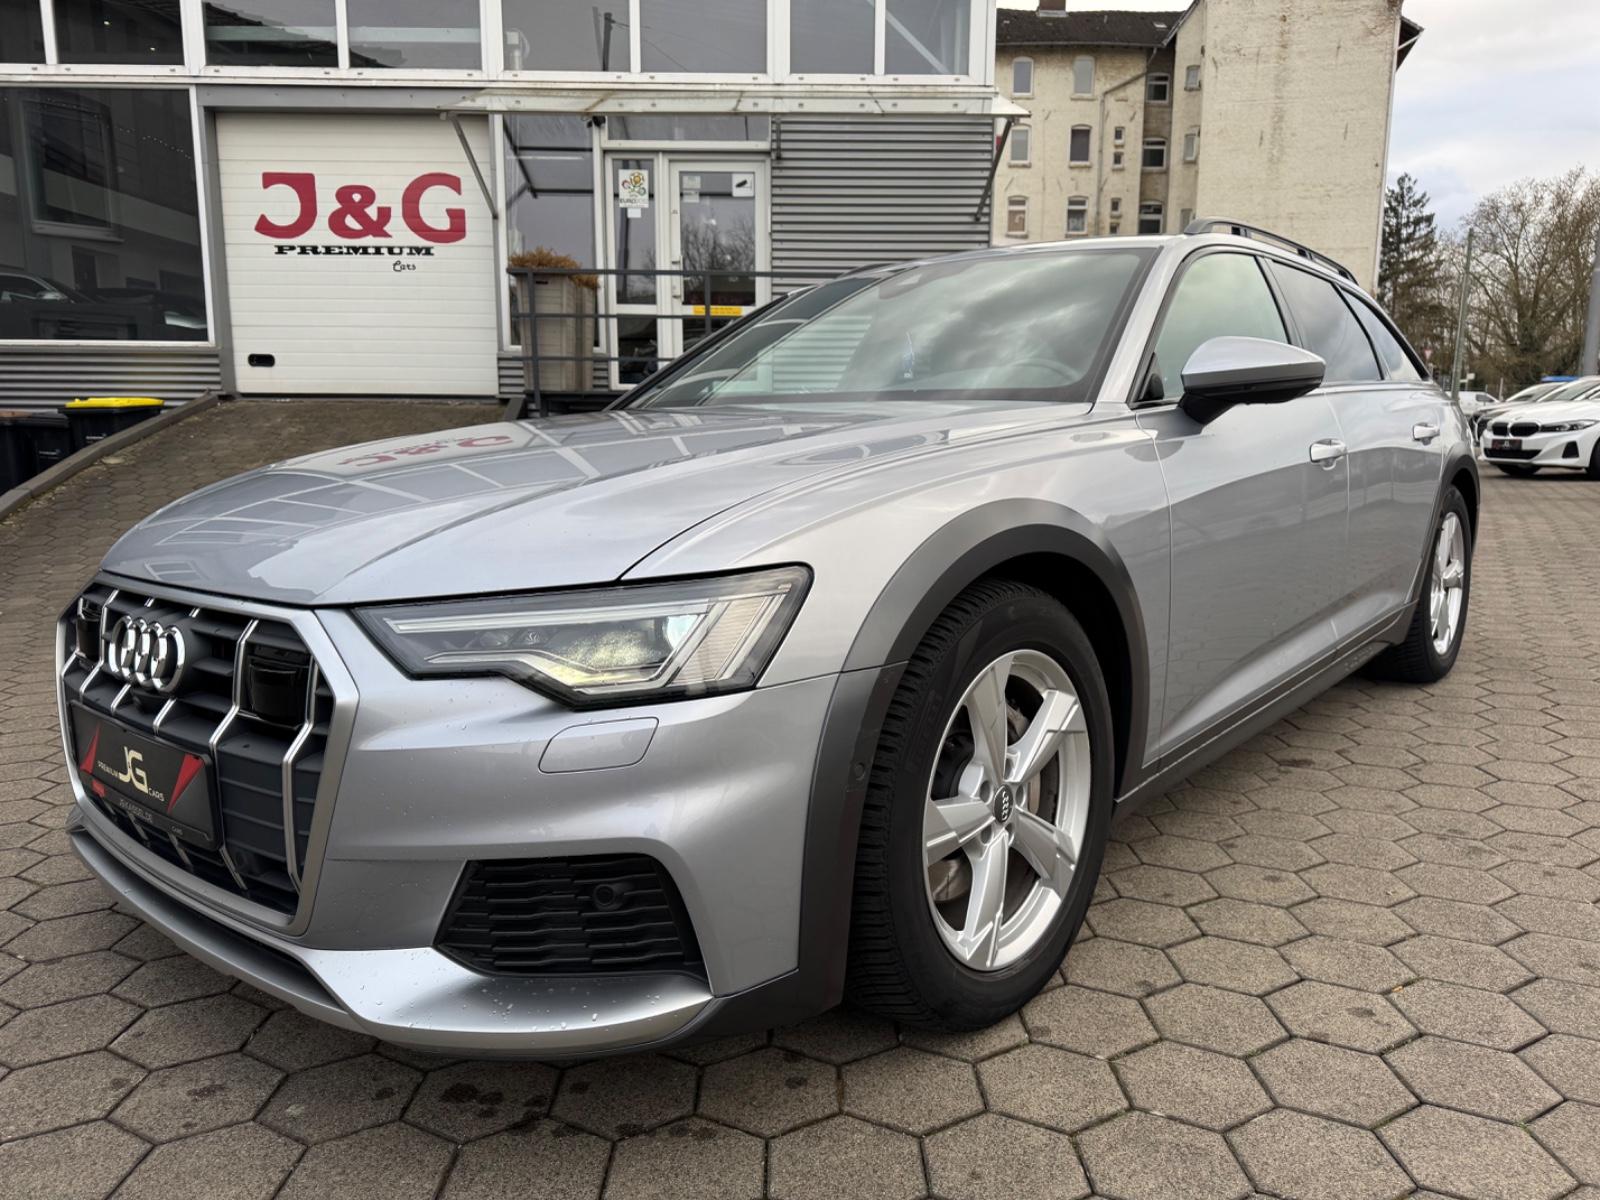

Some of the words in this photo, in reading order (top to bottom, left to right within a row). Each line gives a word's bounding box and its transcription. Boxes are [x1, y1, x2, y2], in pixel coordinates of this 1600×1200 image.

[254, 171, 467, 244] J&G
[274, 244, 435, 257] PREMIUM
[392, 260, 417, 272] Cars
[118, 746, 149, 794] JG
[148, 787, 165, 802] CARS
